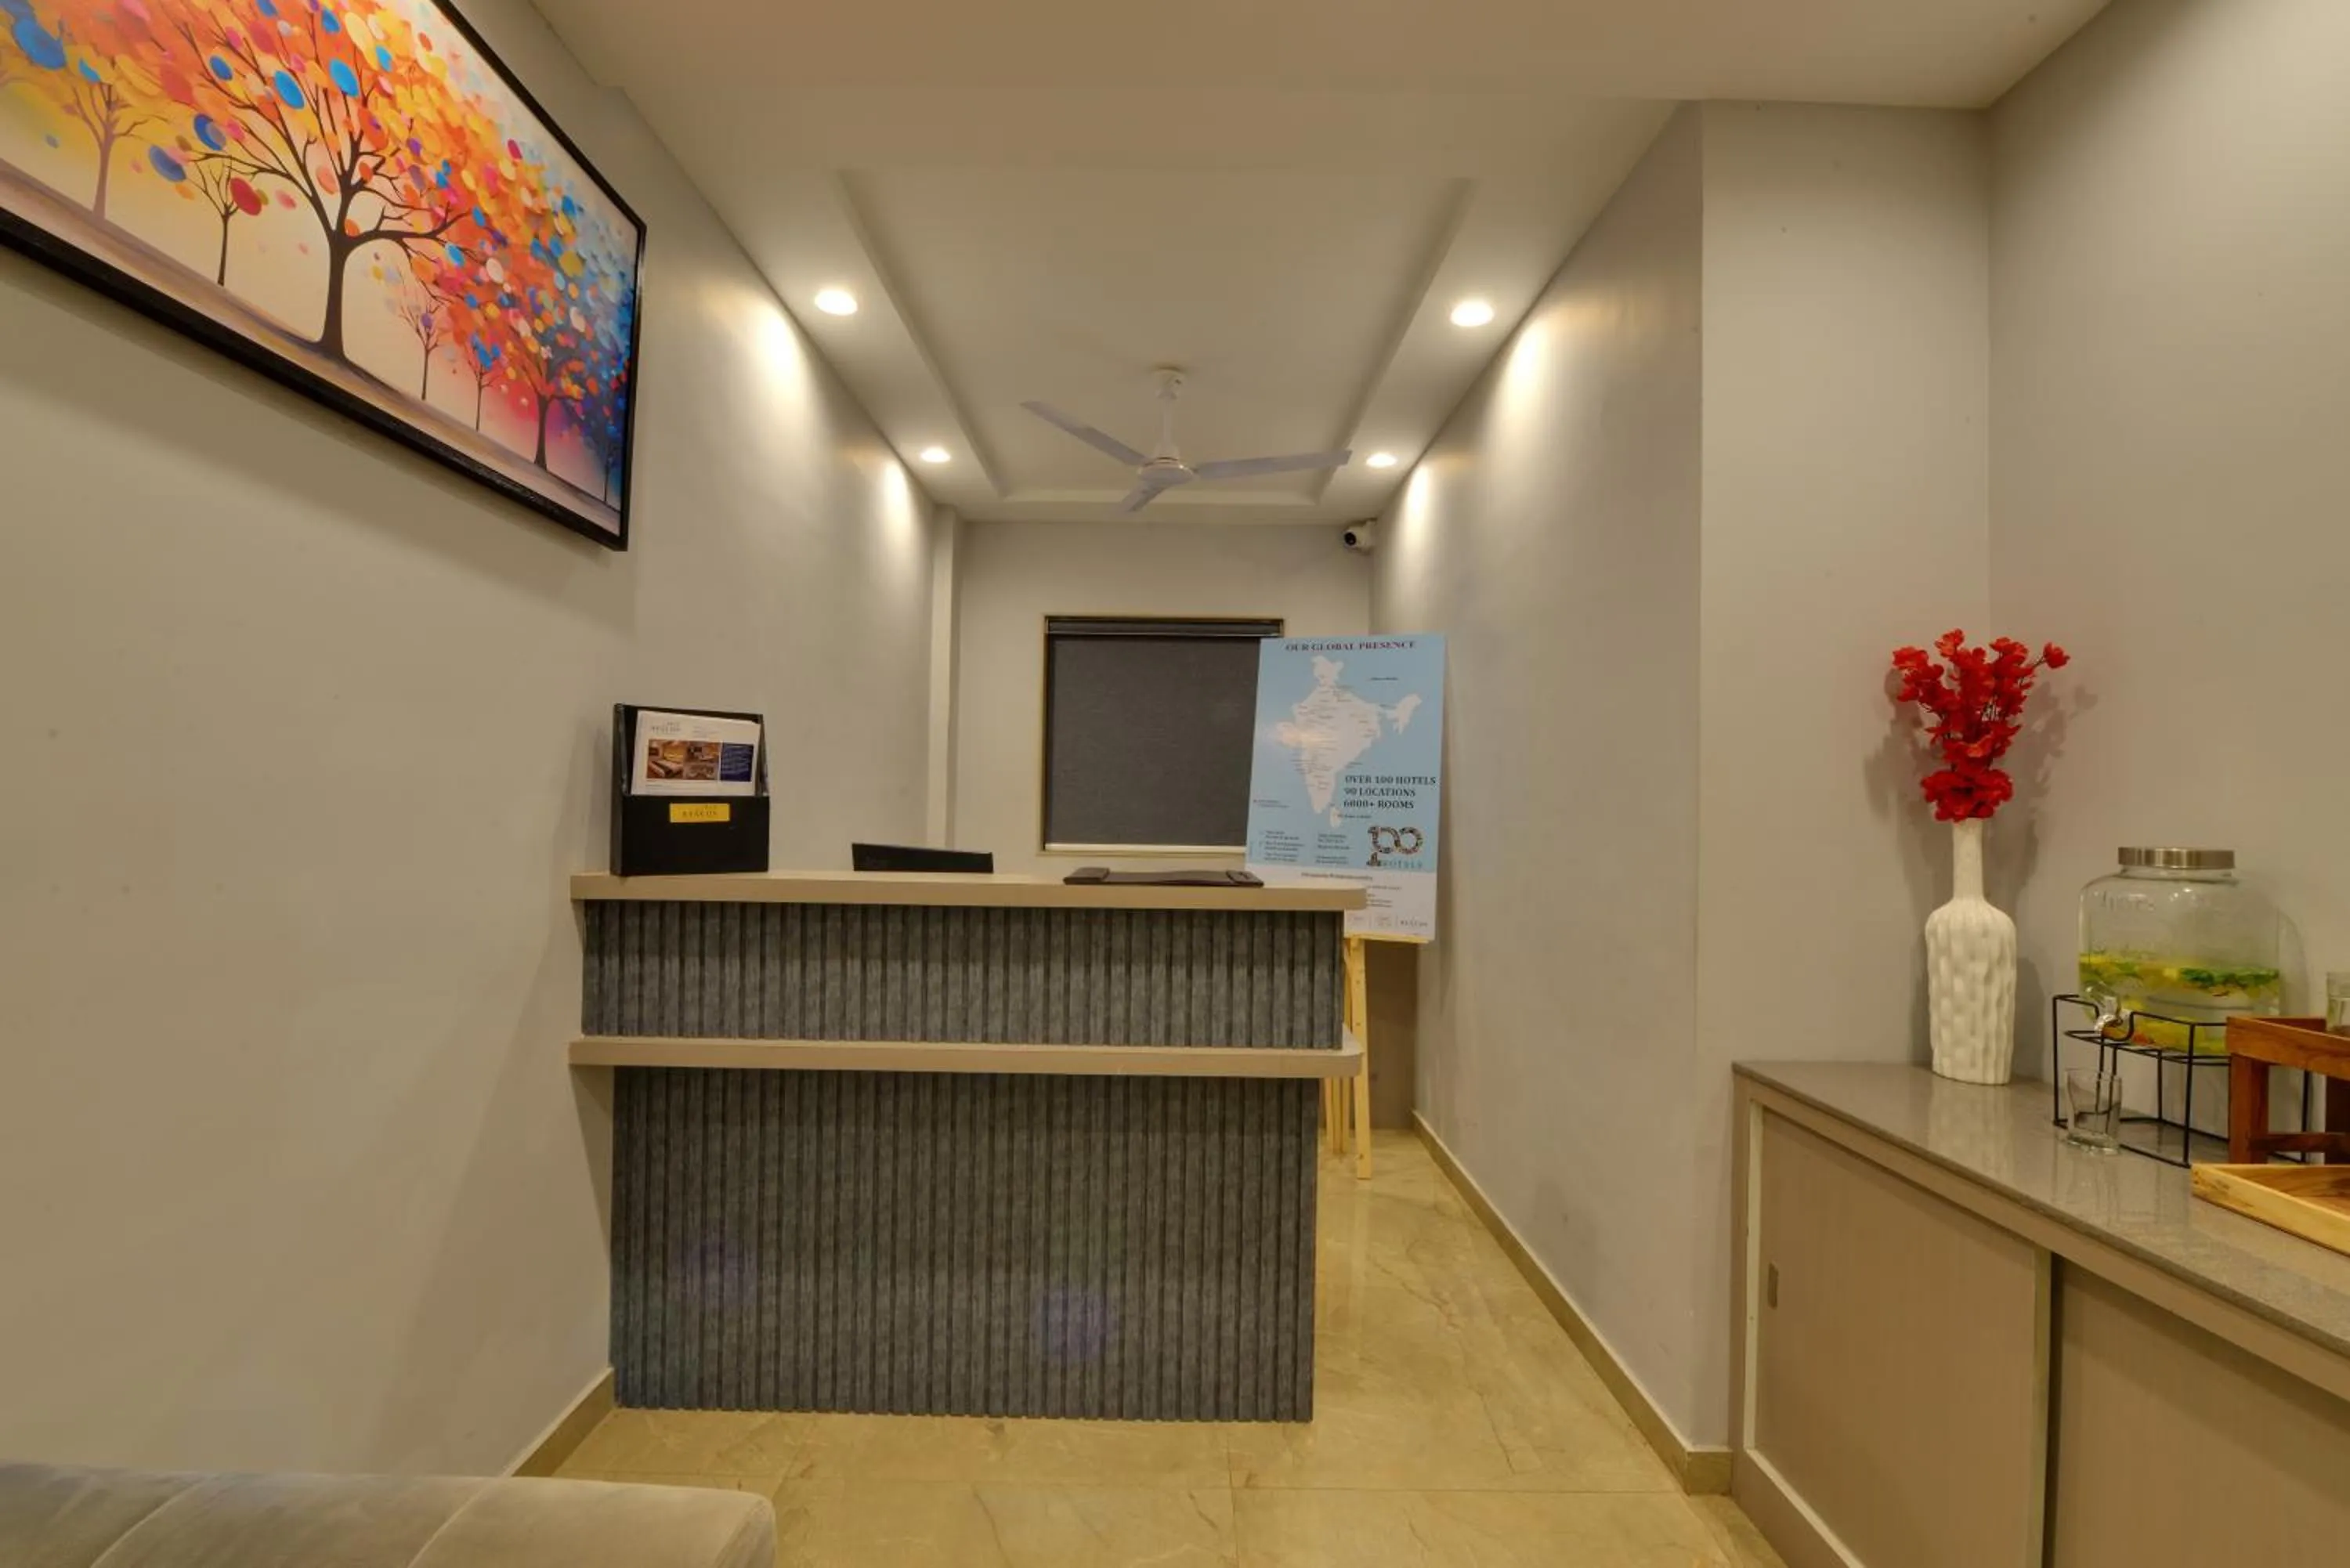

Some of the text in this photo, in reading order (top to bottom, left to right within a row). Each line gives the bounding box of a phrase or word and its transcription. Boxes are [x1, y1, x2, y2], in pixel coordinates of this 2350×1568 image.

[1285, 641, 1415, 652] OUR GLOBAL PRESENCE
[1345, 775, 1437, 785] OVER 100 HOTELS
[1359, 788, 1415, 797] LOCATIONS
[1378, 800, 1415, 808] ROOMS
